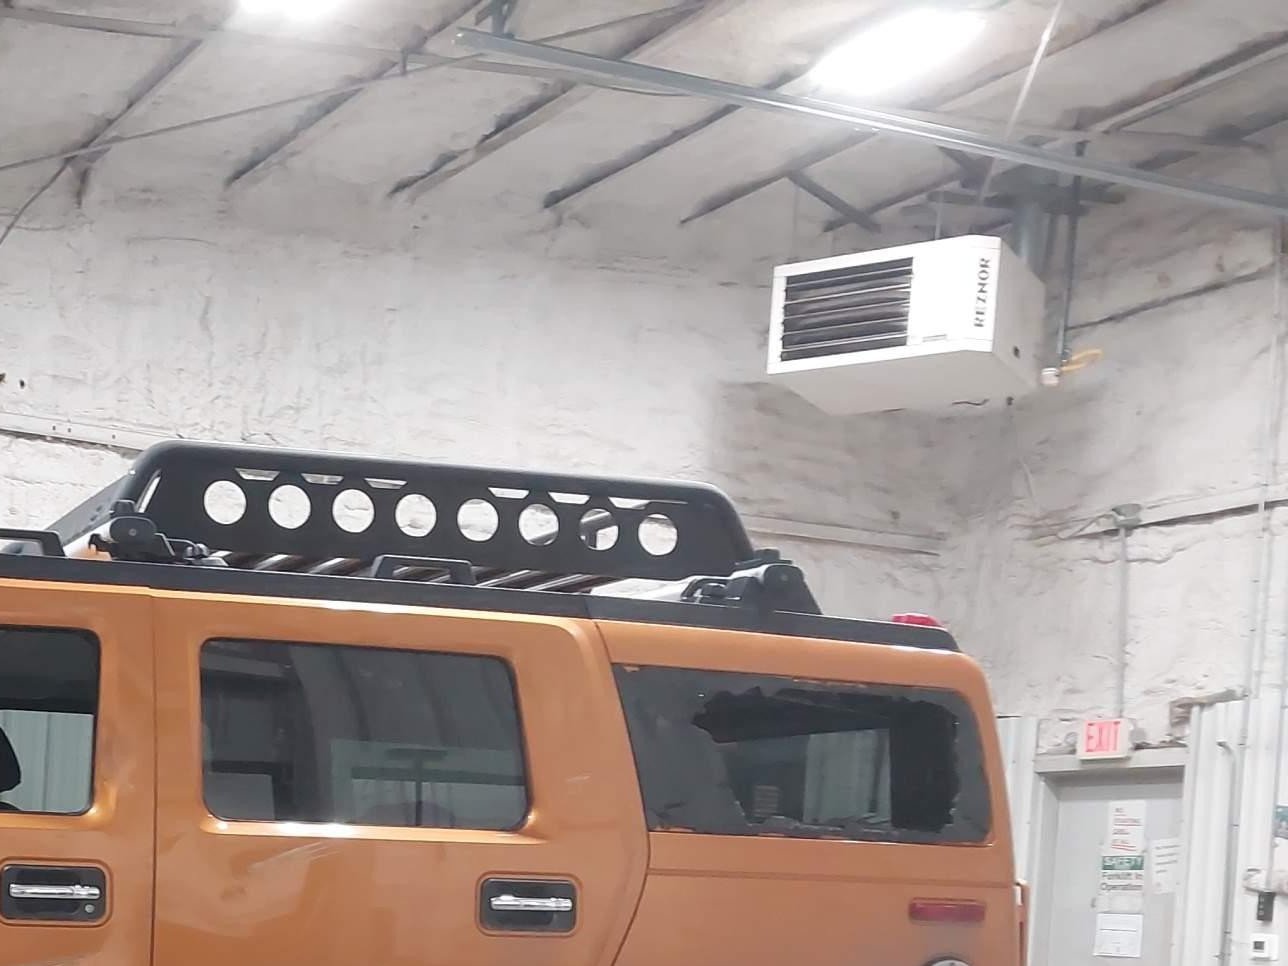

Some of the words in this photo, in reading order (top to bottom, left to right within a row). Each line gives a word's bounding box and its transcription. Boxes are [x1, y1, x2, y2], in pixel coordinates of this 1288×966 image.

[973, 257, 991, 328] REZNOR
[1085, 721, 1121, 753] EXIT
[1103, 856, 1143, 867] SAFETY
